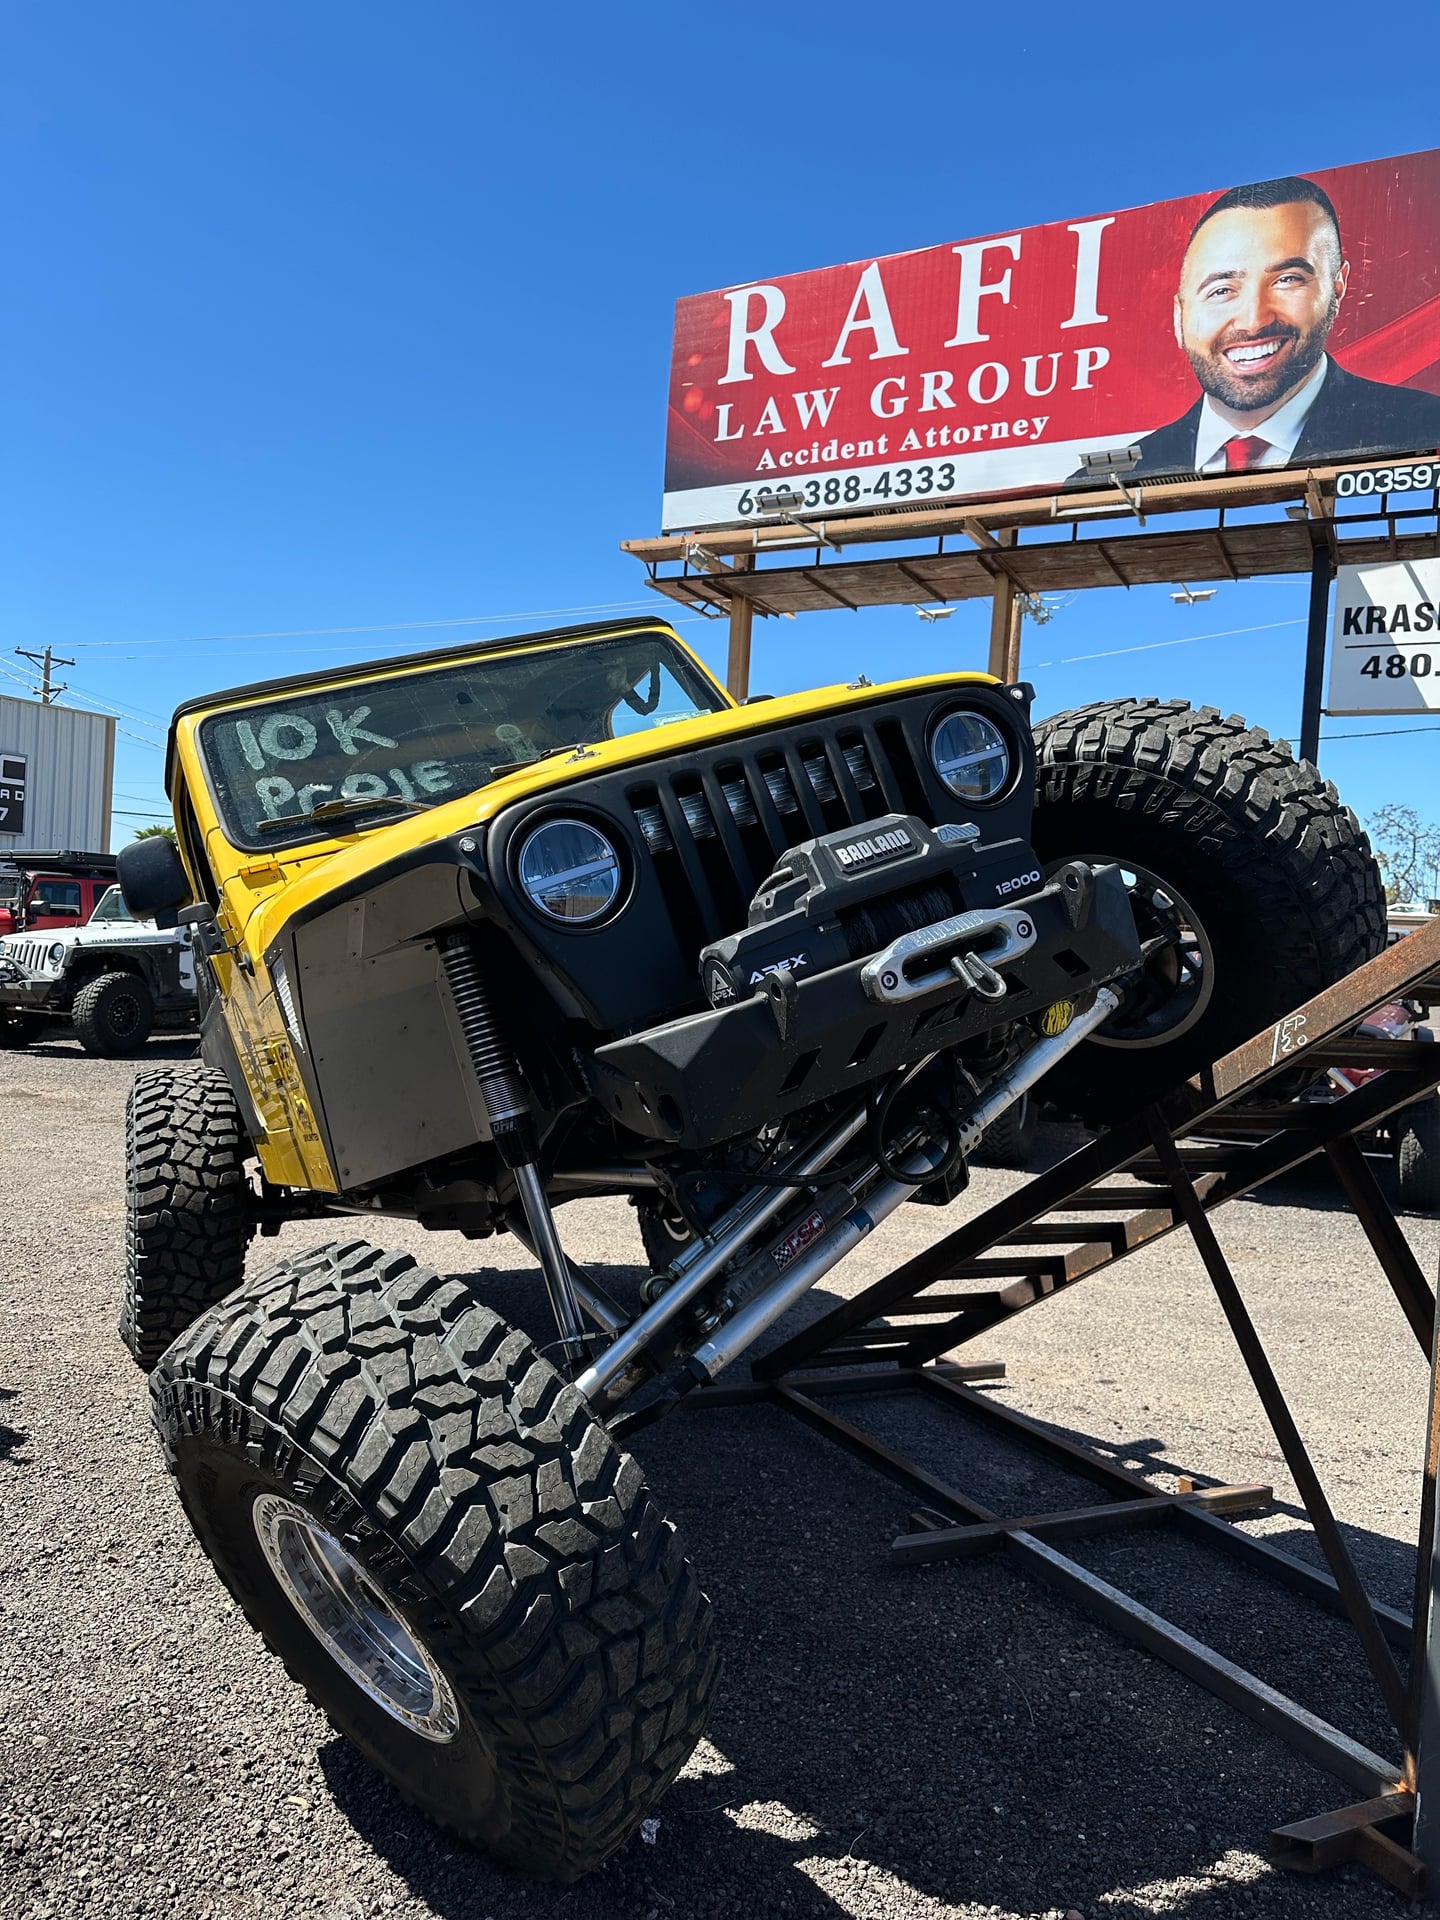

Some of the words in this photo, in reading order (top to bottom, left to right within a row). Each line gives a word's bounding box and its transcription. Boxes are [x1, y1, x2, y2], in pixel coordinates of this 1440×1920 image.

[717, 217, 1116, 385] RAFI
[713, 387, 841, 442] LAW
[870, 346, 1111, 419] GROUP
[755, 433, 889, 471] Accident
[898, 415, 1050, 453] Attorney
[737, 462, 956, 516] 6388-4333
[1343, 602, 1440, 636] KRAS
[235, 705, 399, 770] 10K
[835, 829, 911, 865] BADLAND
[995, 870, 1041, 896] 12000
[749, 952, 808, 985] APEX
[711, 986, 736, 1002] APEX
